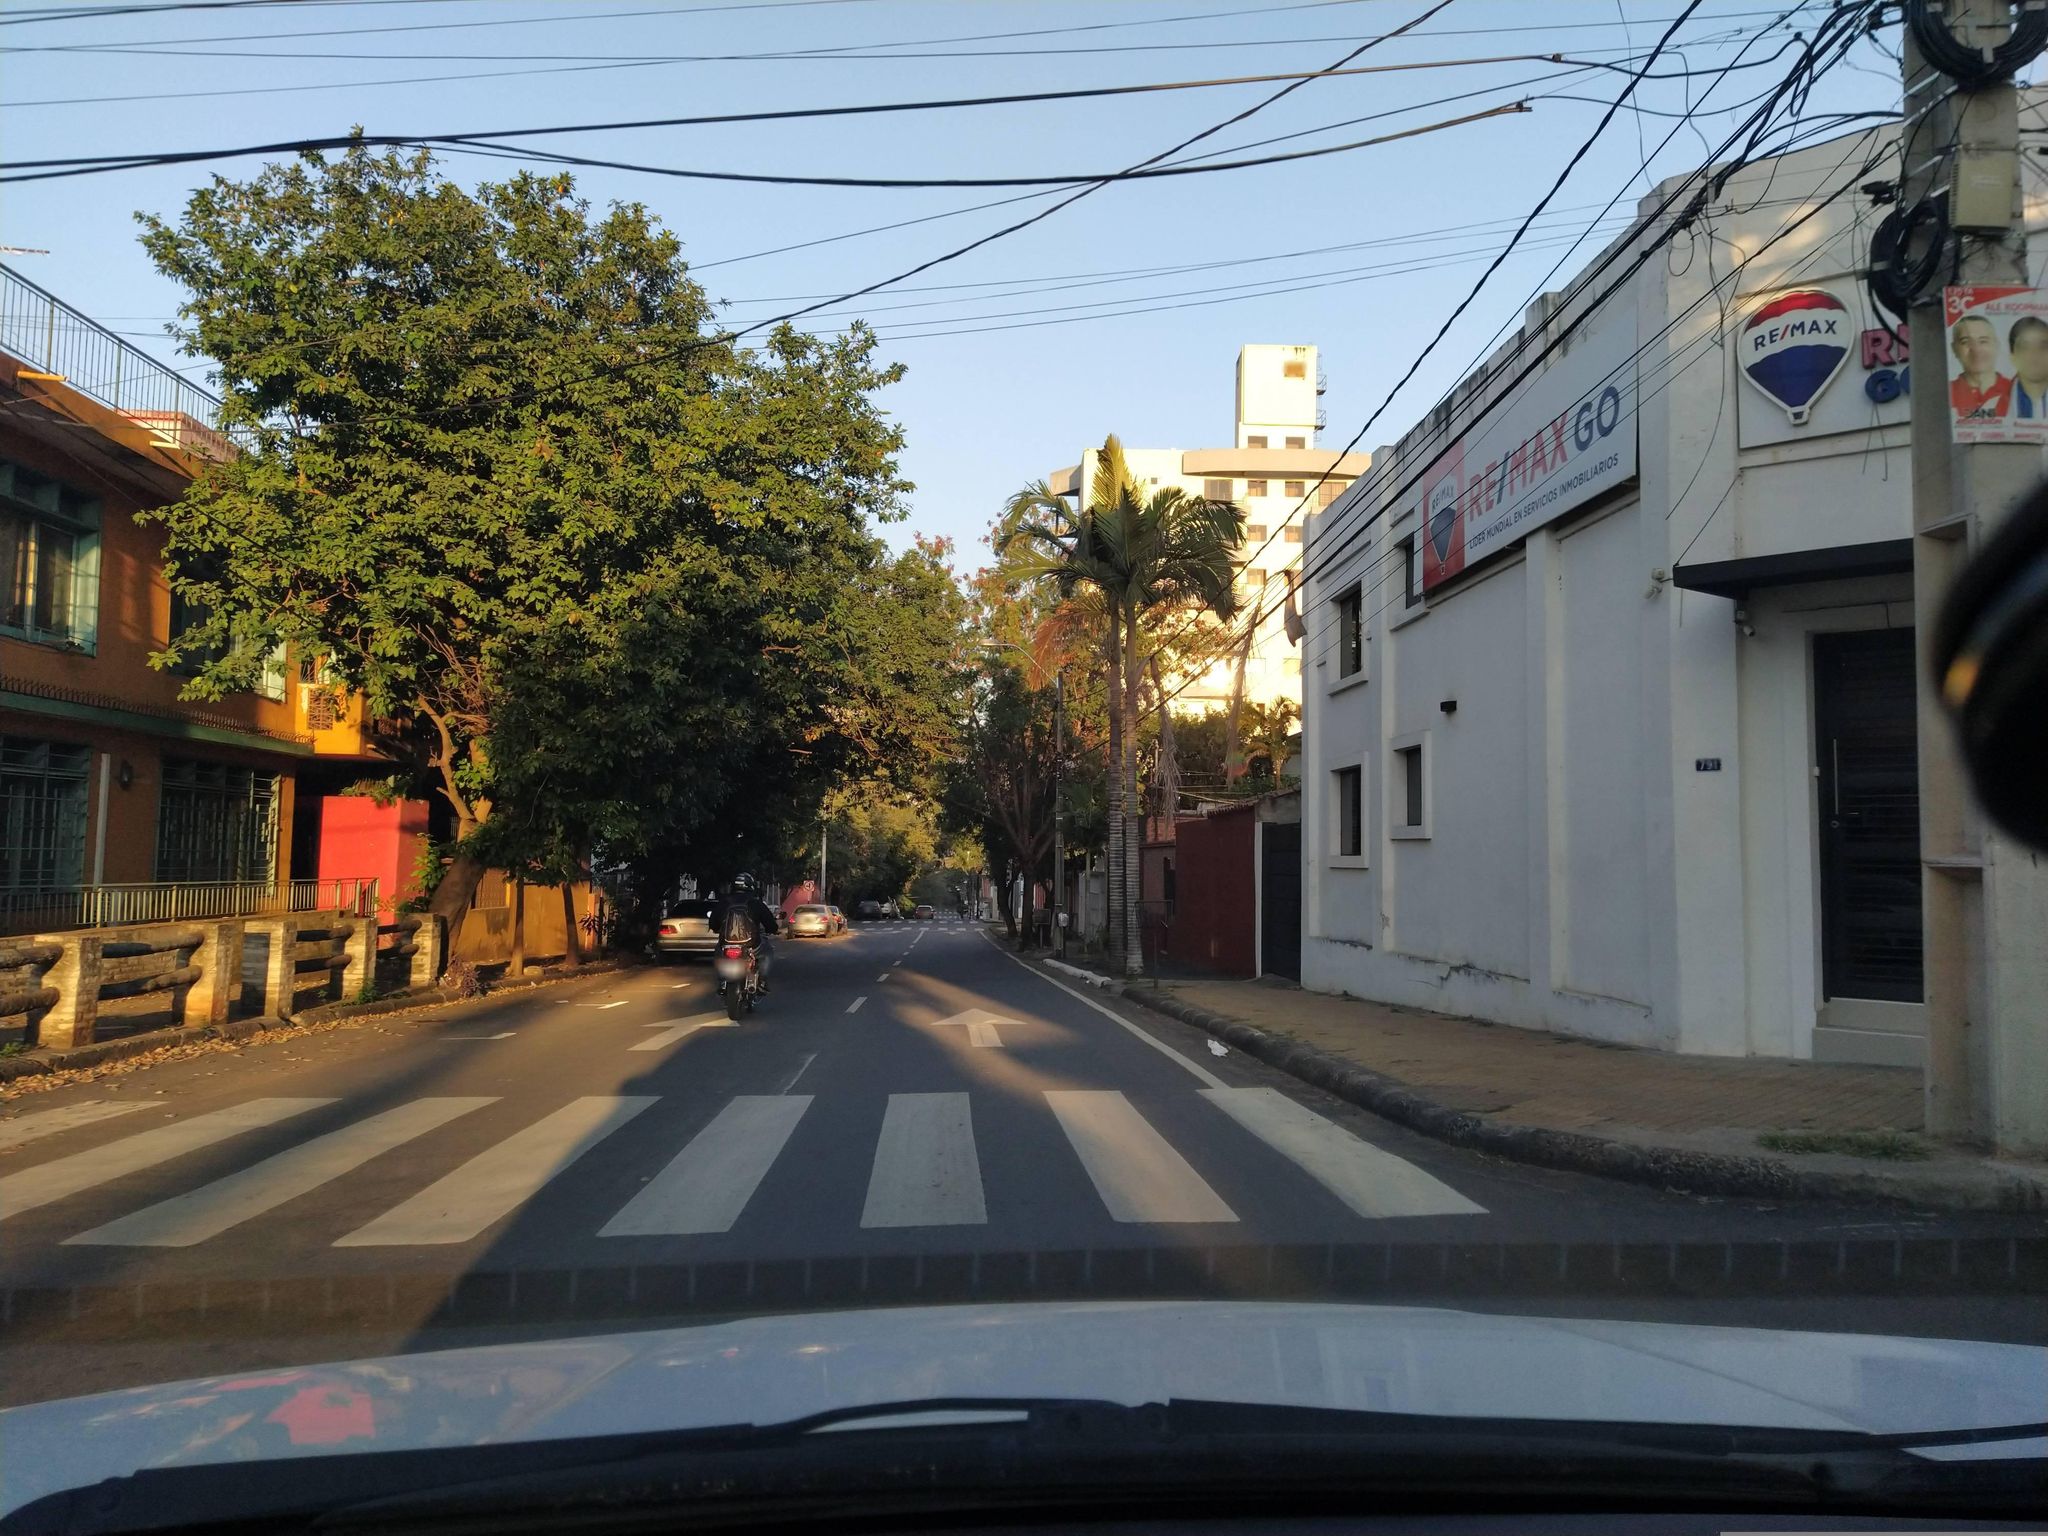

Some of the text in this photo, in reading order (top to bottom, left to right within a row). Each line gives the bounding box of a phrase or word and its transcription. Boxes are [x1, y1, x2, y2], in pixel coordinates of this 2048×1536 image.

[1754, 319, 1838, 352] RE/MAX
[1469, 386, 1620, 522] RE/MAX GO
[1486, 515, 1513, 541] MUNDIAL
[1514, 510, 1523, 525] EN
[1523, 488, 1558, 517] SERVICIOS
[1559, 453, 1620, 496] INMOBILIARIOS
